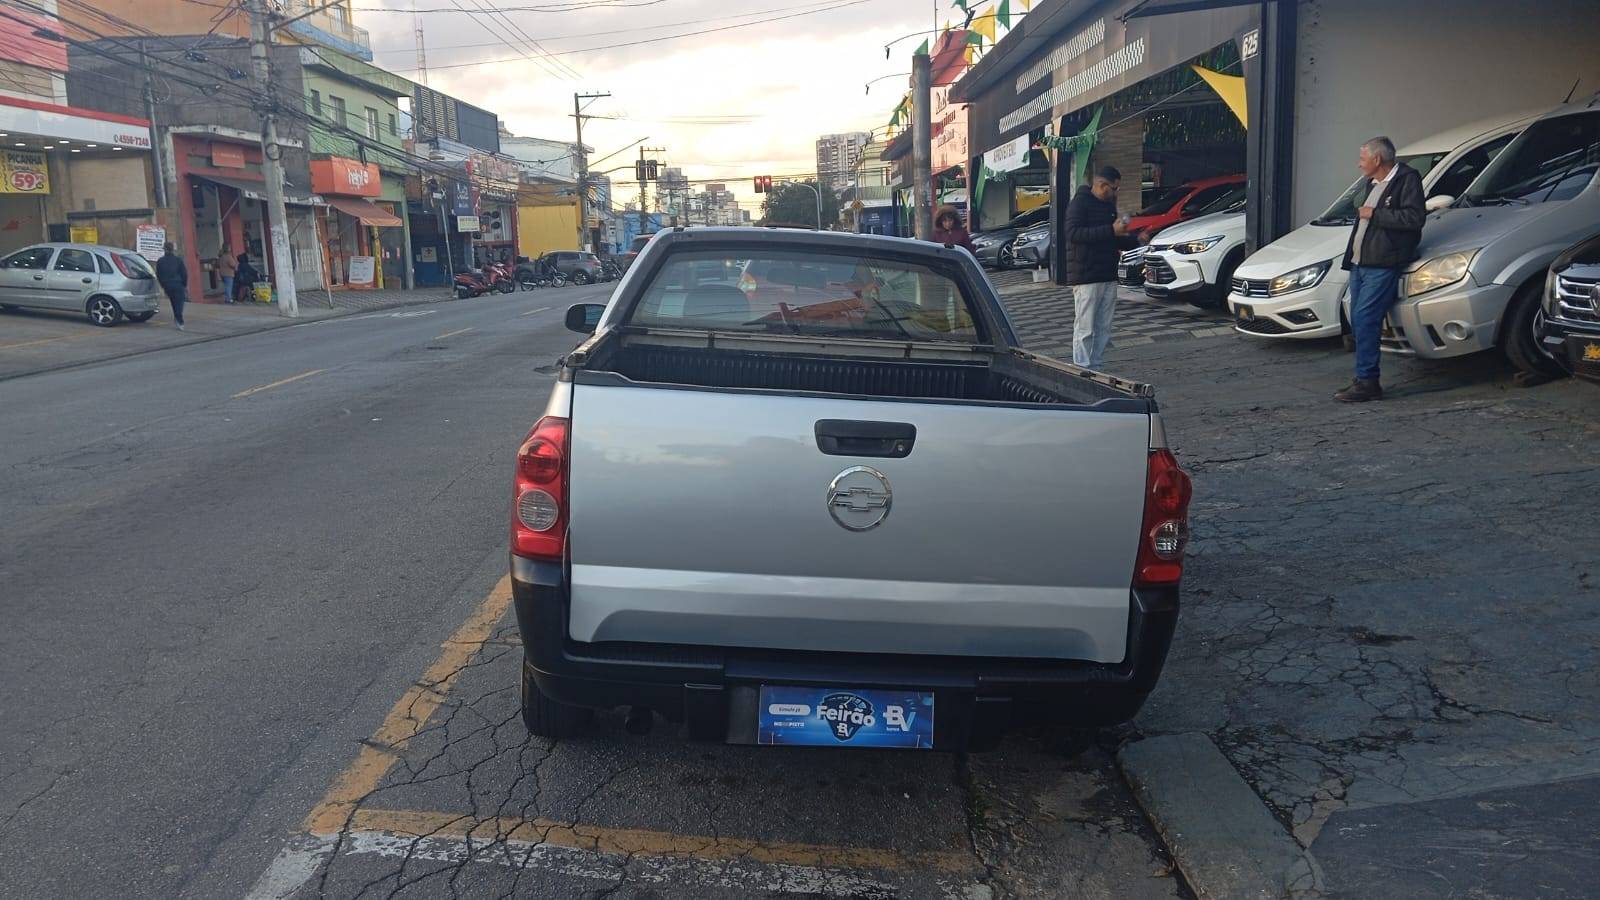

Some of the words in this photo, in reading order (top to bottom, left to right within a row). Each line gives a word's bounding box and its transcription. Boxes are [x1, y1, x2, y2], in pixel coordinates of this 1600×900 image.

[1243, 33, 1258, 58] 625
[15, 174, 34, 188] 59
[816, 705, 875, 727] Feirão
[883, 705, 916, 732] BV
